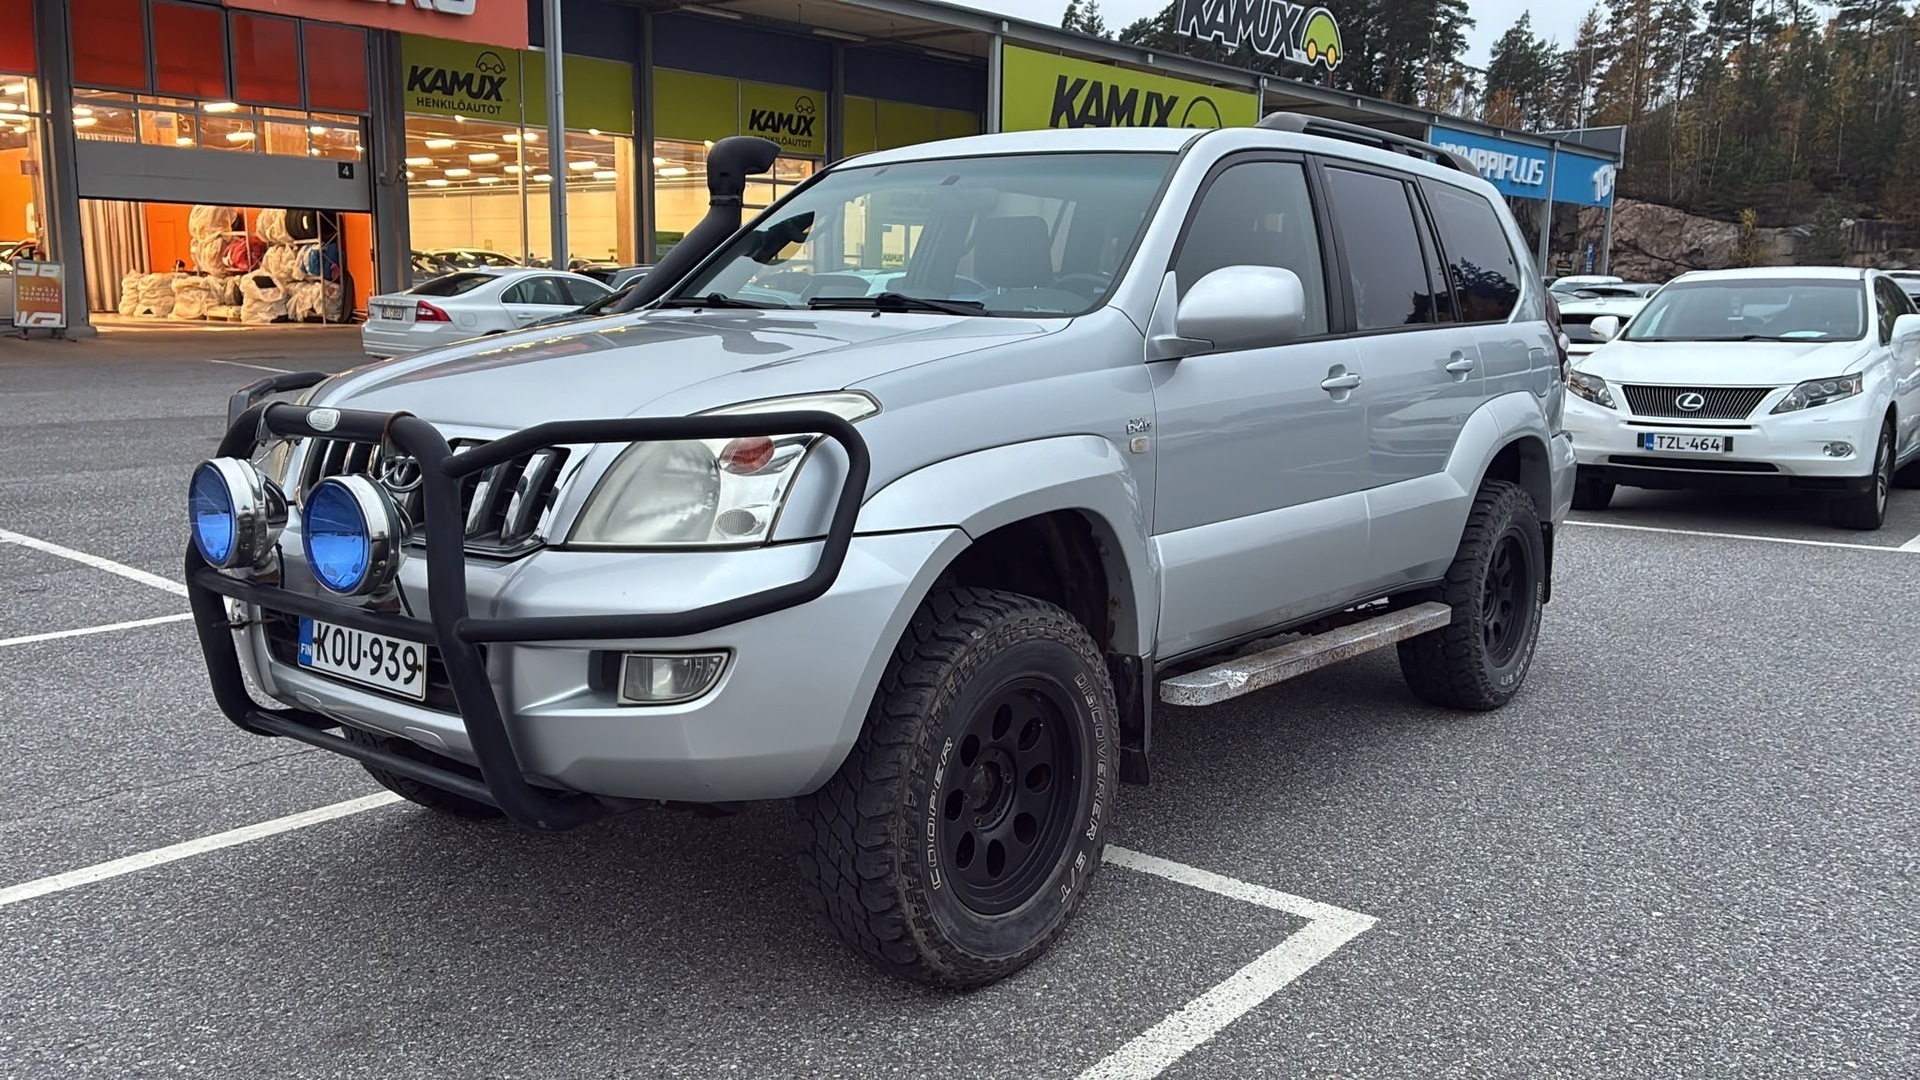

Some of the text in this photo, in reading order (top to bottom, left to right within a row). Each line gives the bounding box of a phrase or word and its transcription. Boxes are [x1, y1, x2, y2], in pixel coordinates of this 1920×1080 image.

[1178, 0, 1304, 60] KAMUX
[407, 65, 507, 102] KAMUX
[416, 97, 502, 115] HENKILÖAUTOT
[1049, 74, 1179, 128] KAMUX
[748, 108, 816, 137] KAMUX
[754, 134, 812, 148] NKILÖAUTOT
[342, 165, 350, 176] 4
[1656, 435, 1721, 452] TZL-464
[300, 643, 312, 657] FIN
[315, 622, 419, 685] KOU-939
[1073, 672, 1107, 841] DISCOVERER
[926, 736, 953, 890] COOPER
